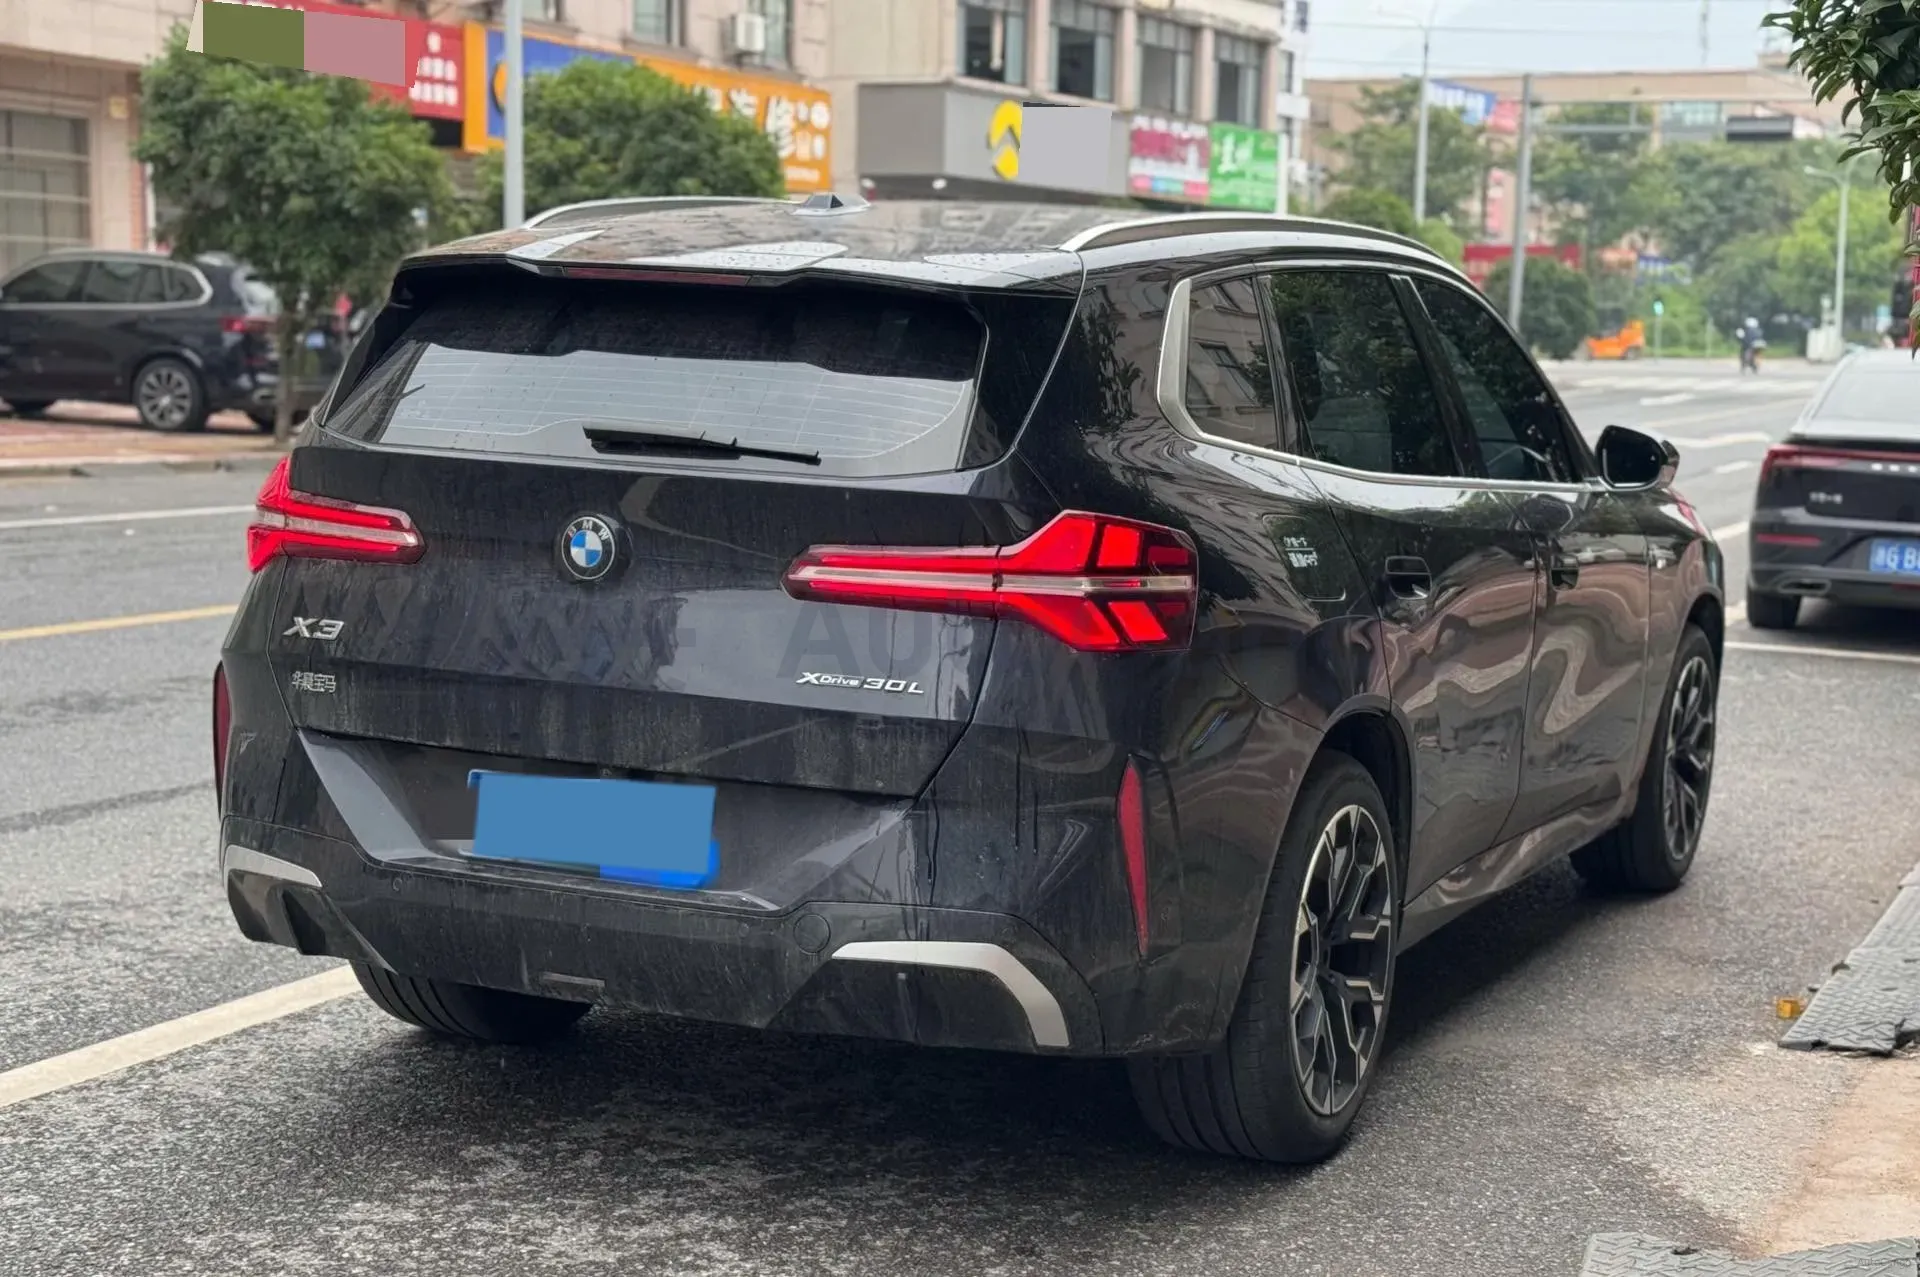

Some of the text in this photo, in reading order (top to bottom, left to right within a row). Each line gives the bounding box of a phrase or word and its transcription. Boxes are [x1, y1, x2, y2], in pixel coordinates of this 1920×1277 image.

[567, 520, 610, 541] BMW
[282, 616, 345, 640] X3
[291, 670, 337, 693] 华晨宝马
